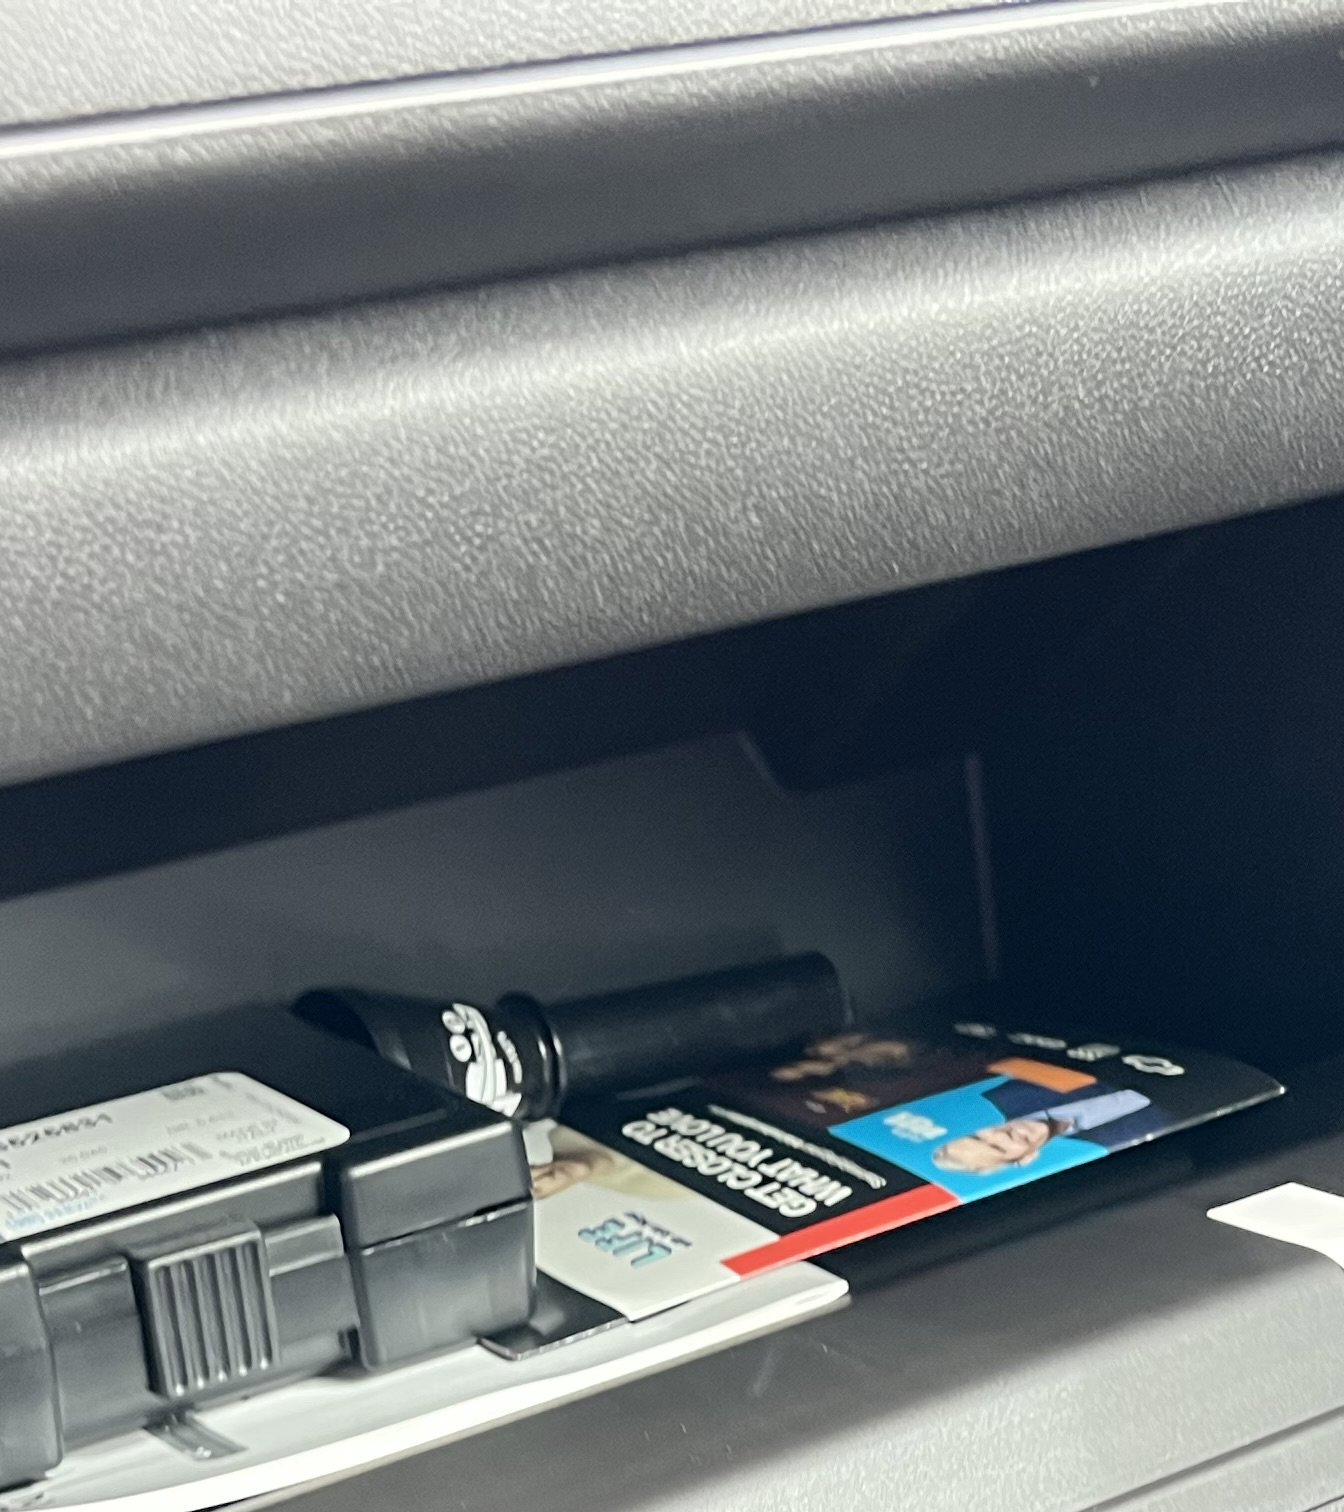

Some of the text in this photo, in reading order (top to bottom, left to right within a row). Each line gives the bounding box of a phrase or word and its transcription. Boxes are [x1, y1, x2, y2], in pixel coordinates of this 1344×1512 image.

[621, 1120, 668, 1145] TO
[646, 1107, 725, 1142] LOVE
[653, 1136, 762, 1190] CLOSER
[707, 1133, 773, 1167] YOU
[745, 1181, 817, 1218] GET
[759, 1157, 853, 1207] WHAT
